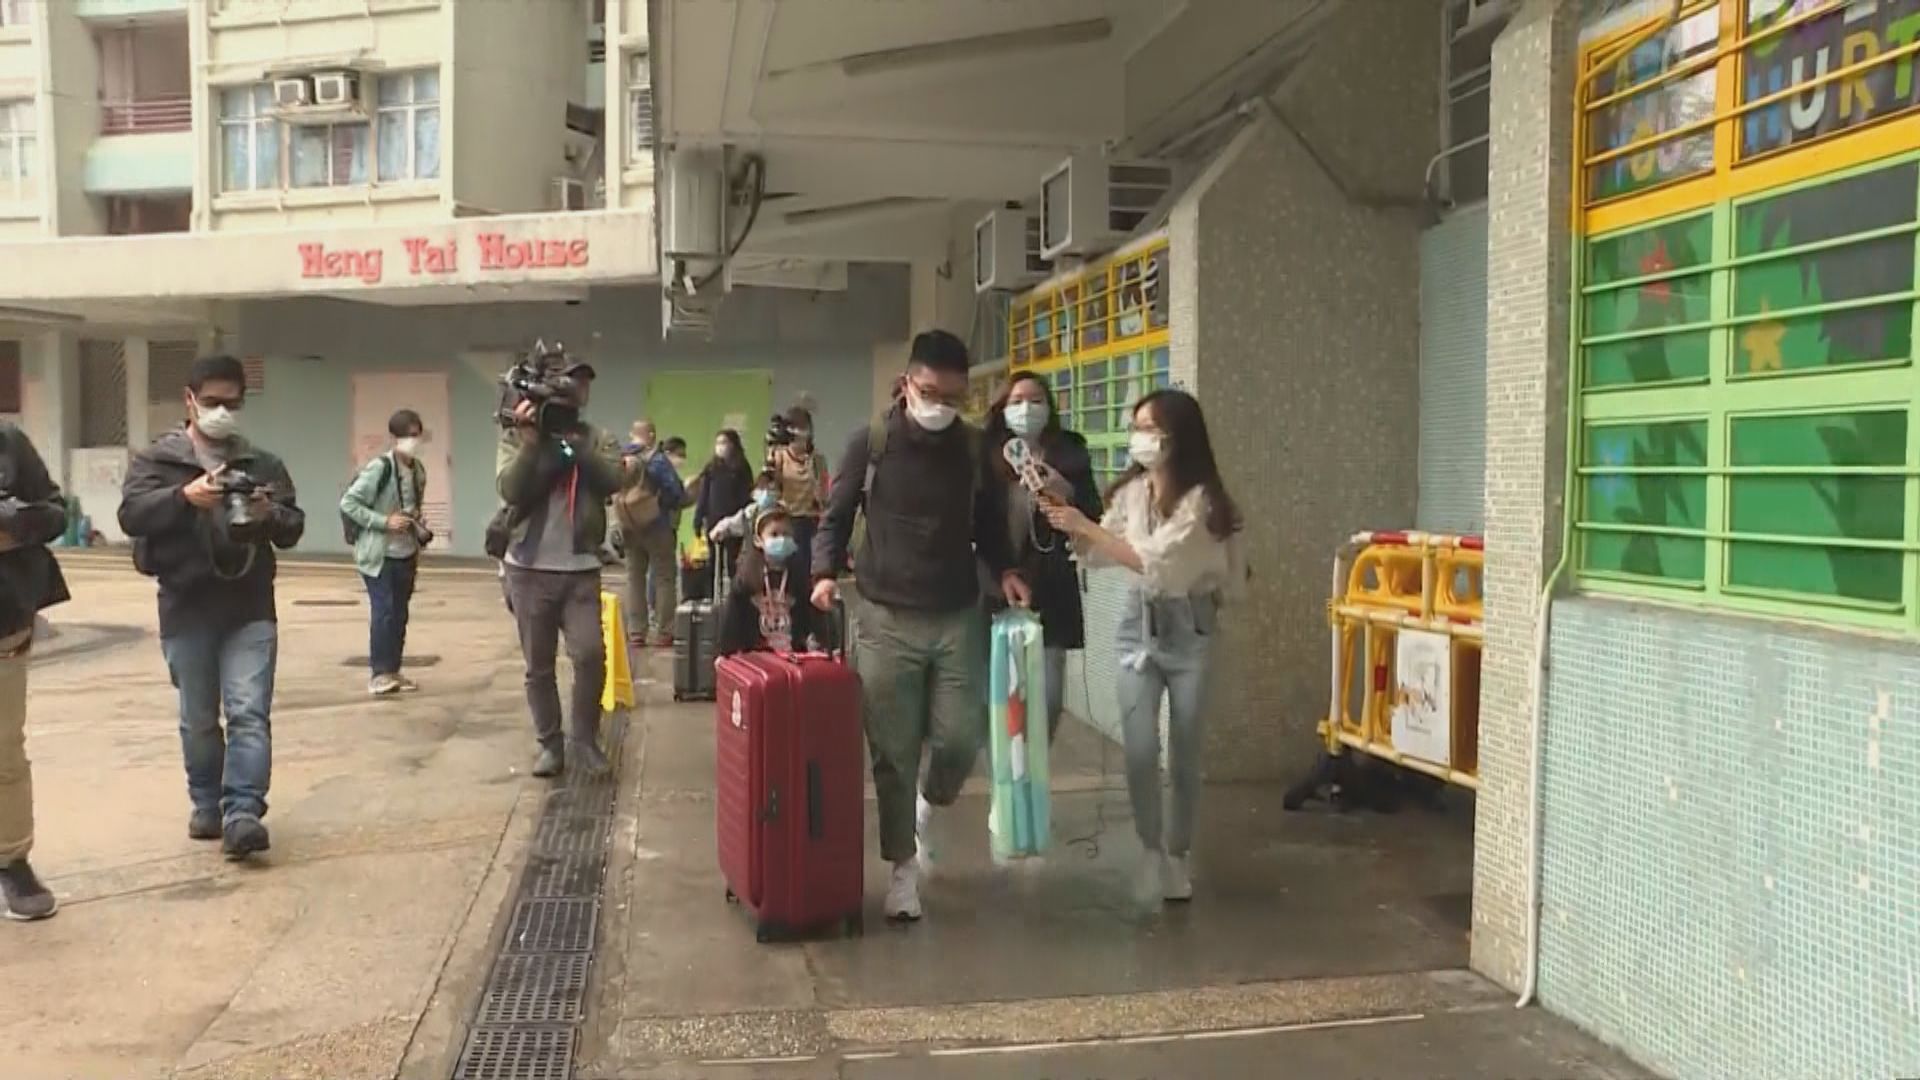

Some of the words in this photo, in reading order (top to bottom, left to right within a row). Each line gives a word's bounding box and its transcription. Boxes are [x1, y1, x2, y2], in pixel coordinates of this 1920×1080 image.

[298, 243, 383, 283] Heng
[402, 236, 458, 274] Tai
[477, 232, 589, 271] House
